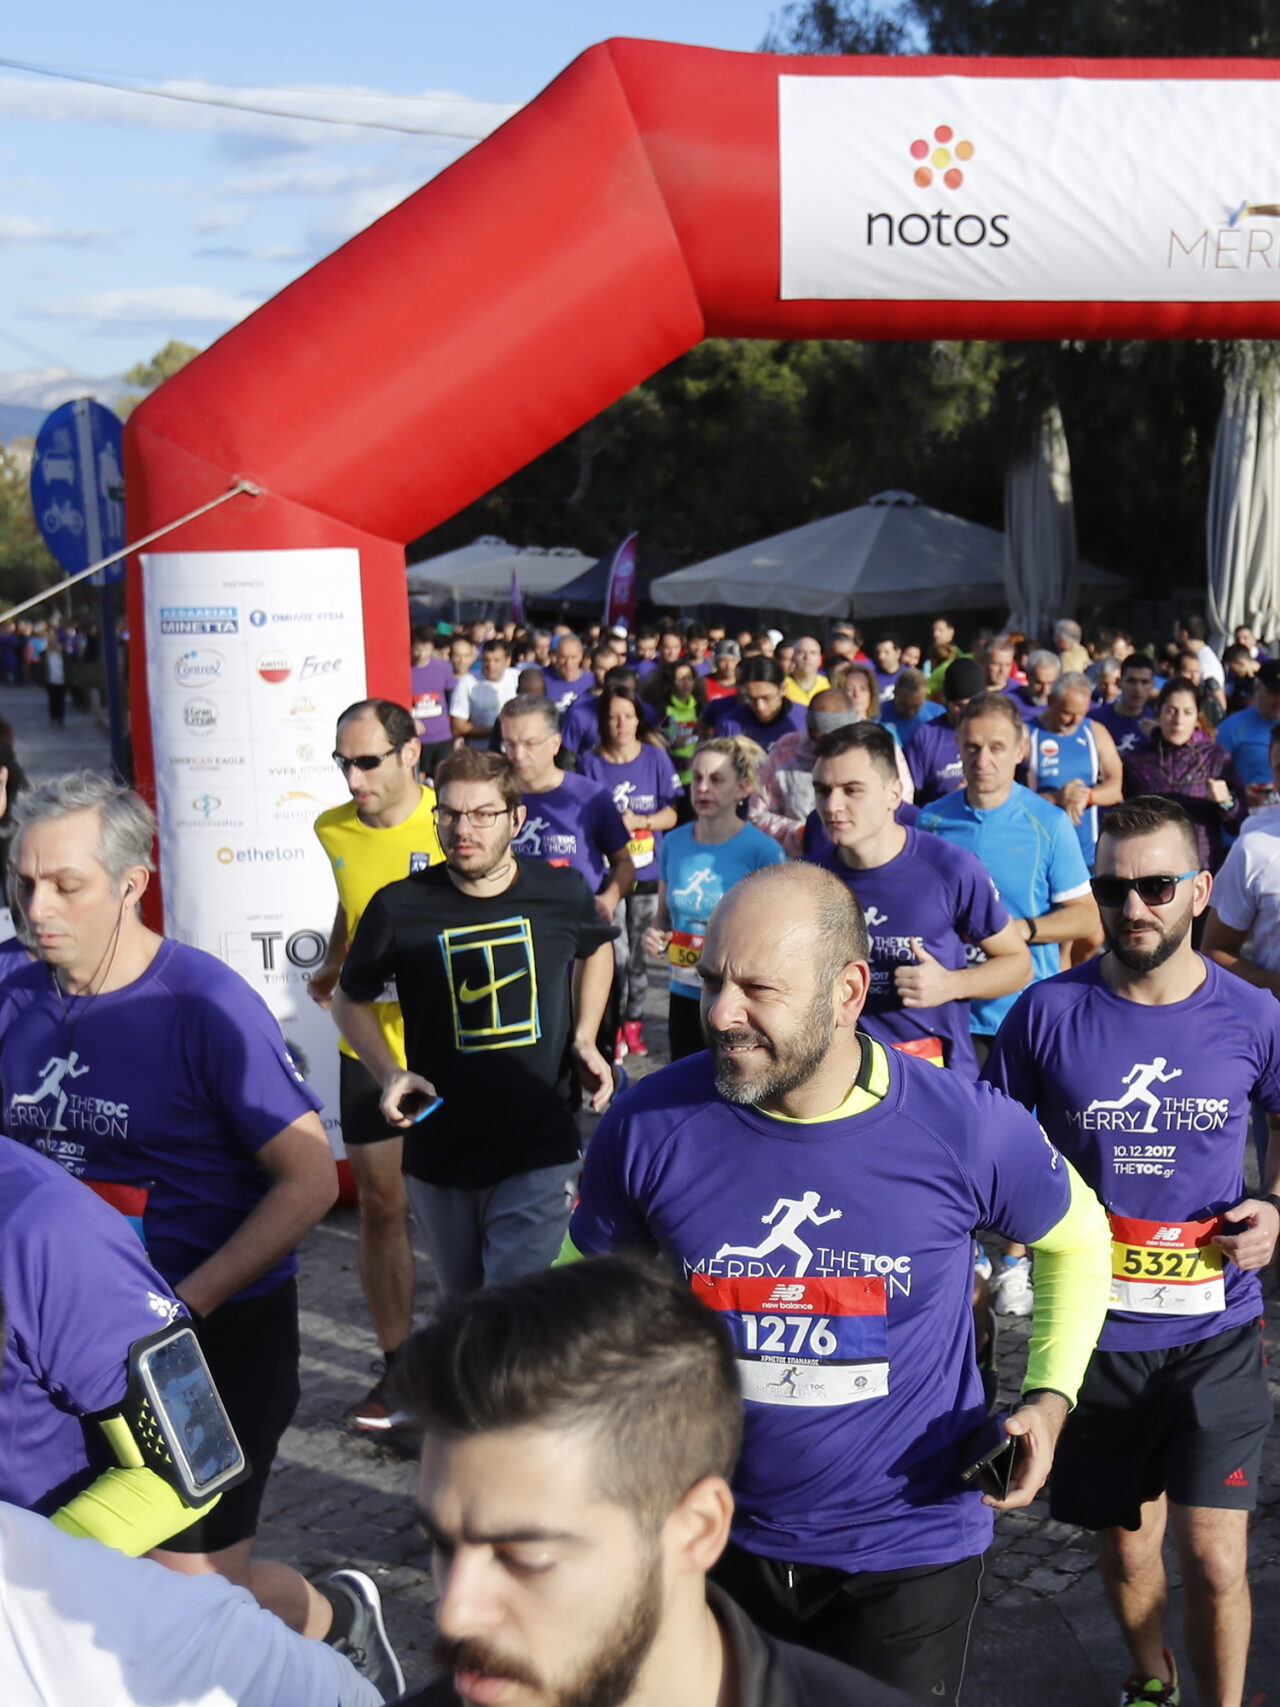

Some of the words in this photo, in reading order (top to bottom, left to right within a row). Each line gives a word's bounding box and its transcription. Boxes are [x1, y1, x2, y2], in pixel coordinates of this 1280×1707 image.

[867, 208, 1010, 247] notos
[162, 620, 237, 633] MINETTA
[301, 655, 343, 679] Free
[215, 756, 244, 765] EAGLE
[236, 847, 305, 863] ethelon
[679, 948, 702, 965] 50
[5, 1105, 52, 1127] ERRY
[69, 1109, 128, 1140] THON
[1066, 1109, 1140, 1131] MERRY
[1162, 1111, 1229, 1132] THON
[1113, 1145, 1176, 1158] 10.12.2017
[1113, 1163, 1175, 1178] THETOC.gr
[1123, 1248, 1203, 1278] 5327
[780, 1302, 813, 1310] balance
[742, 1313, 838, 1356] 1276
